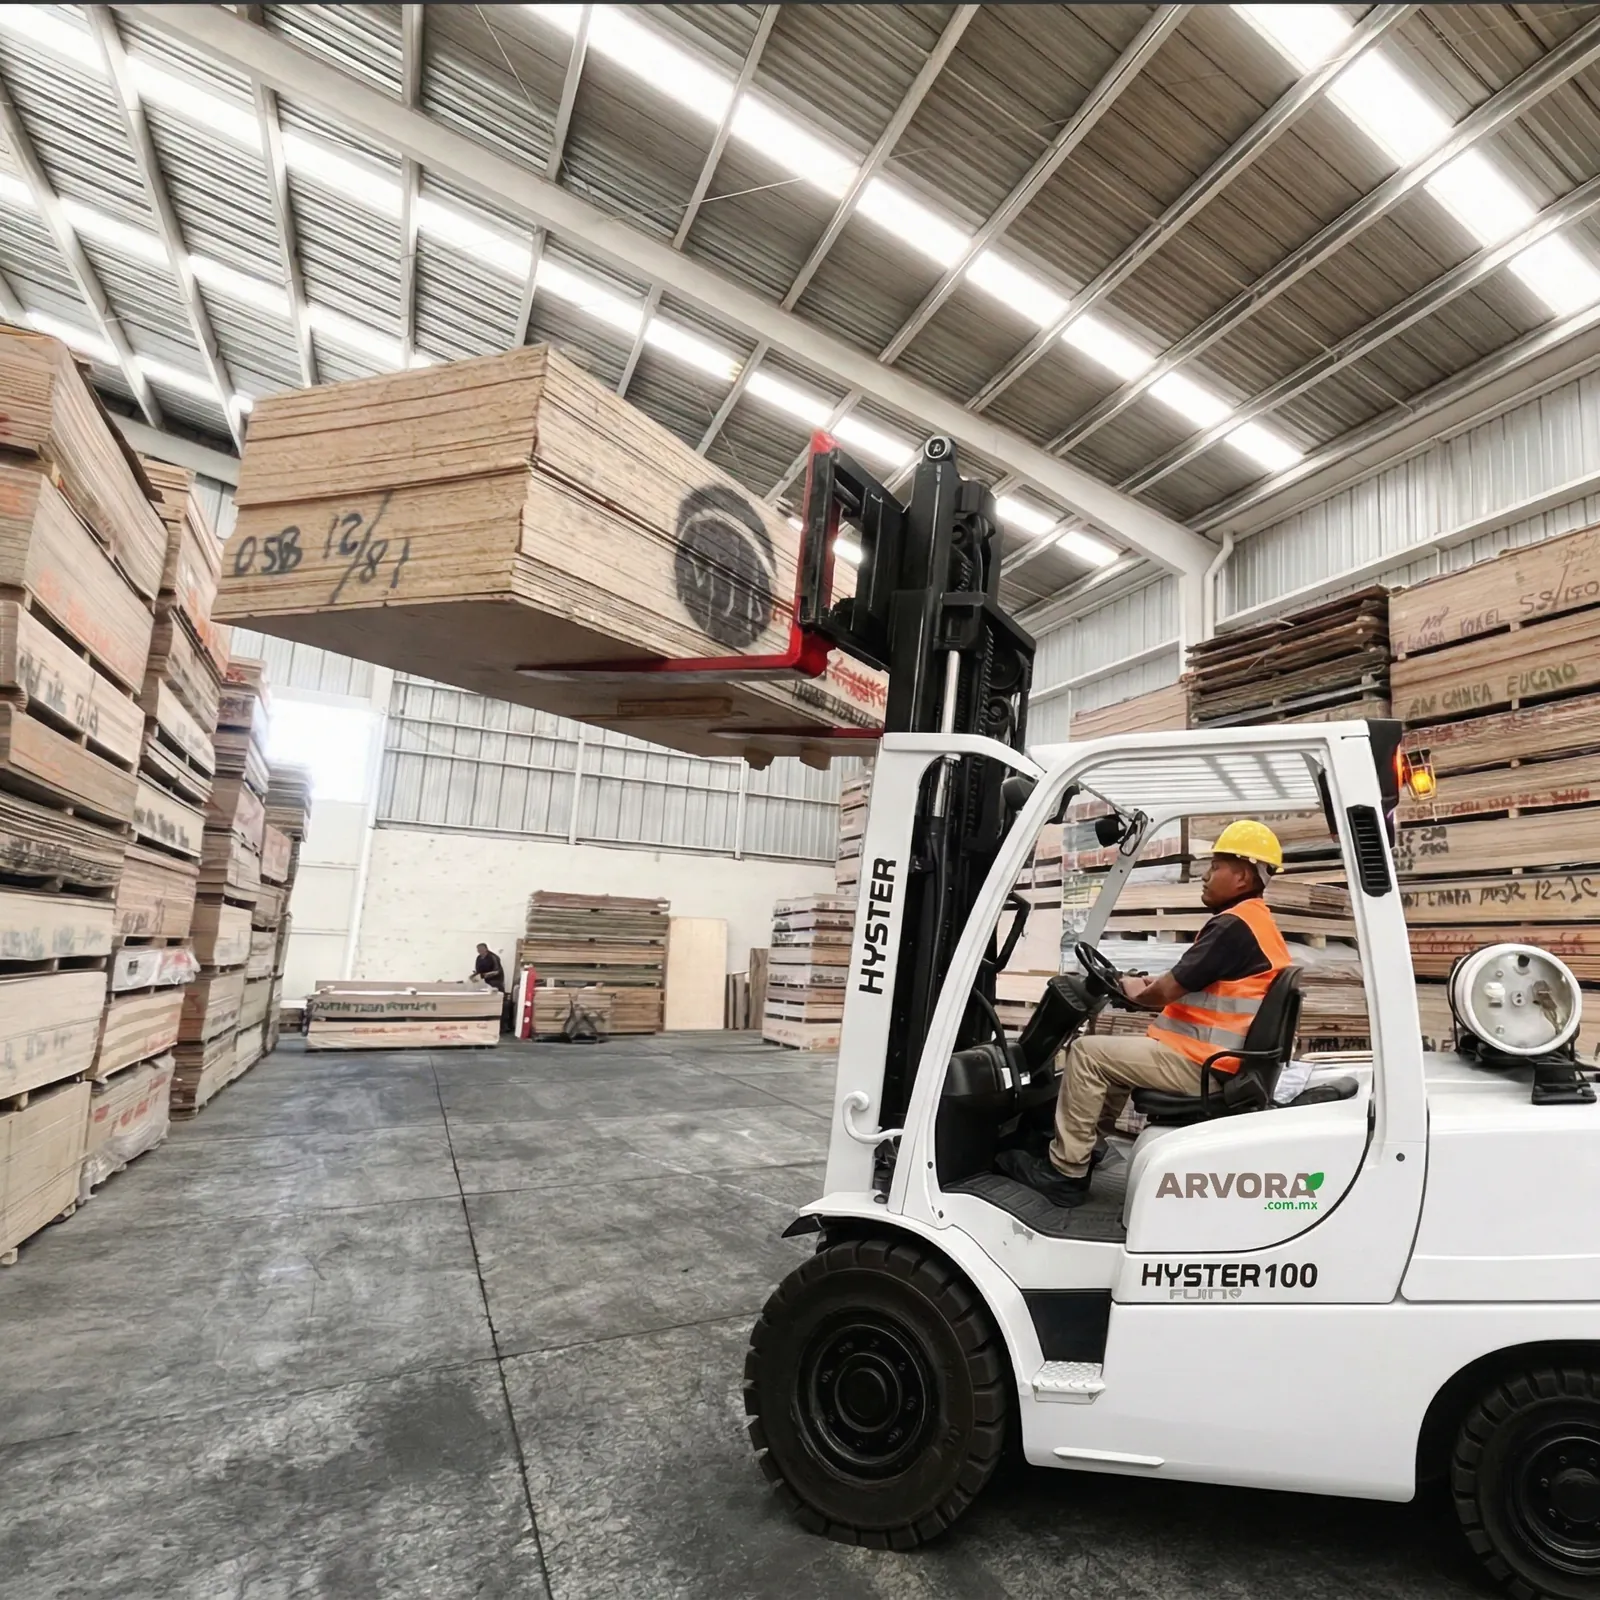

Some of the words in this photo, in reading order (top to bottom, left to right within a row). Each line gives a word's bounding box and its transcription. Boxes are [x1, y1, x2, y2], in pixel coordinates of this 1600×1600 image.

[858, 857, 897, 995] HYSTER
[1155, 1172, 1317, 1199] ARVORA
[1263, 1201, 1318, 1211] .com.mx
